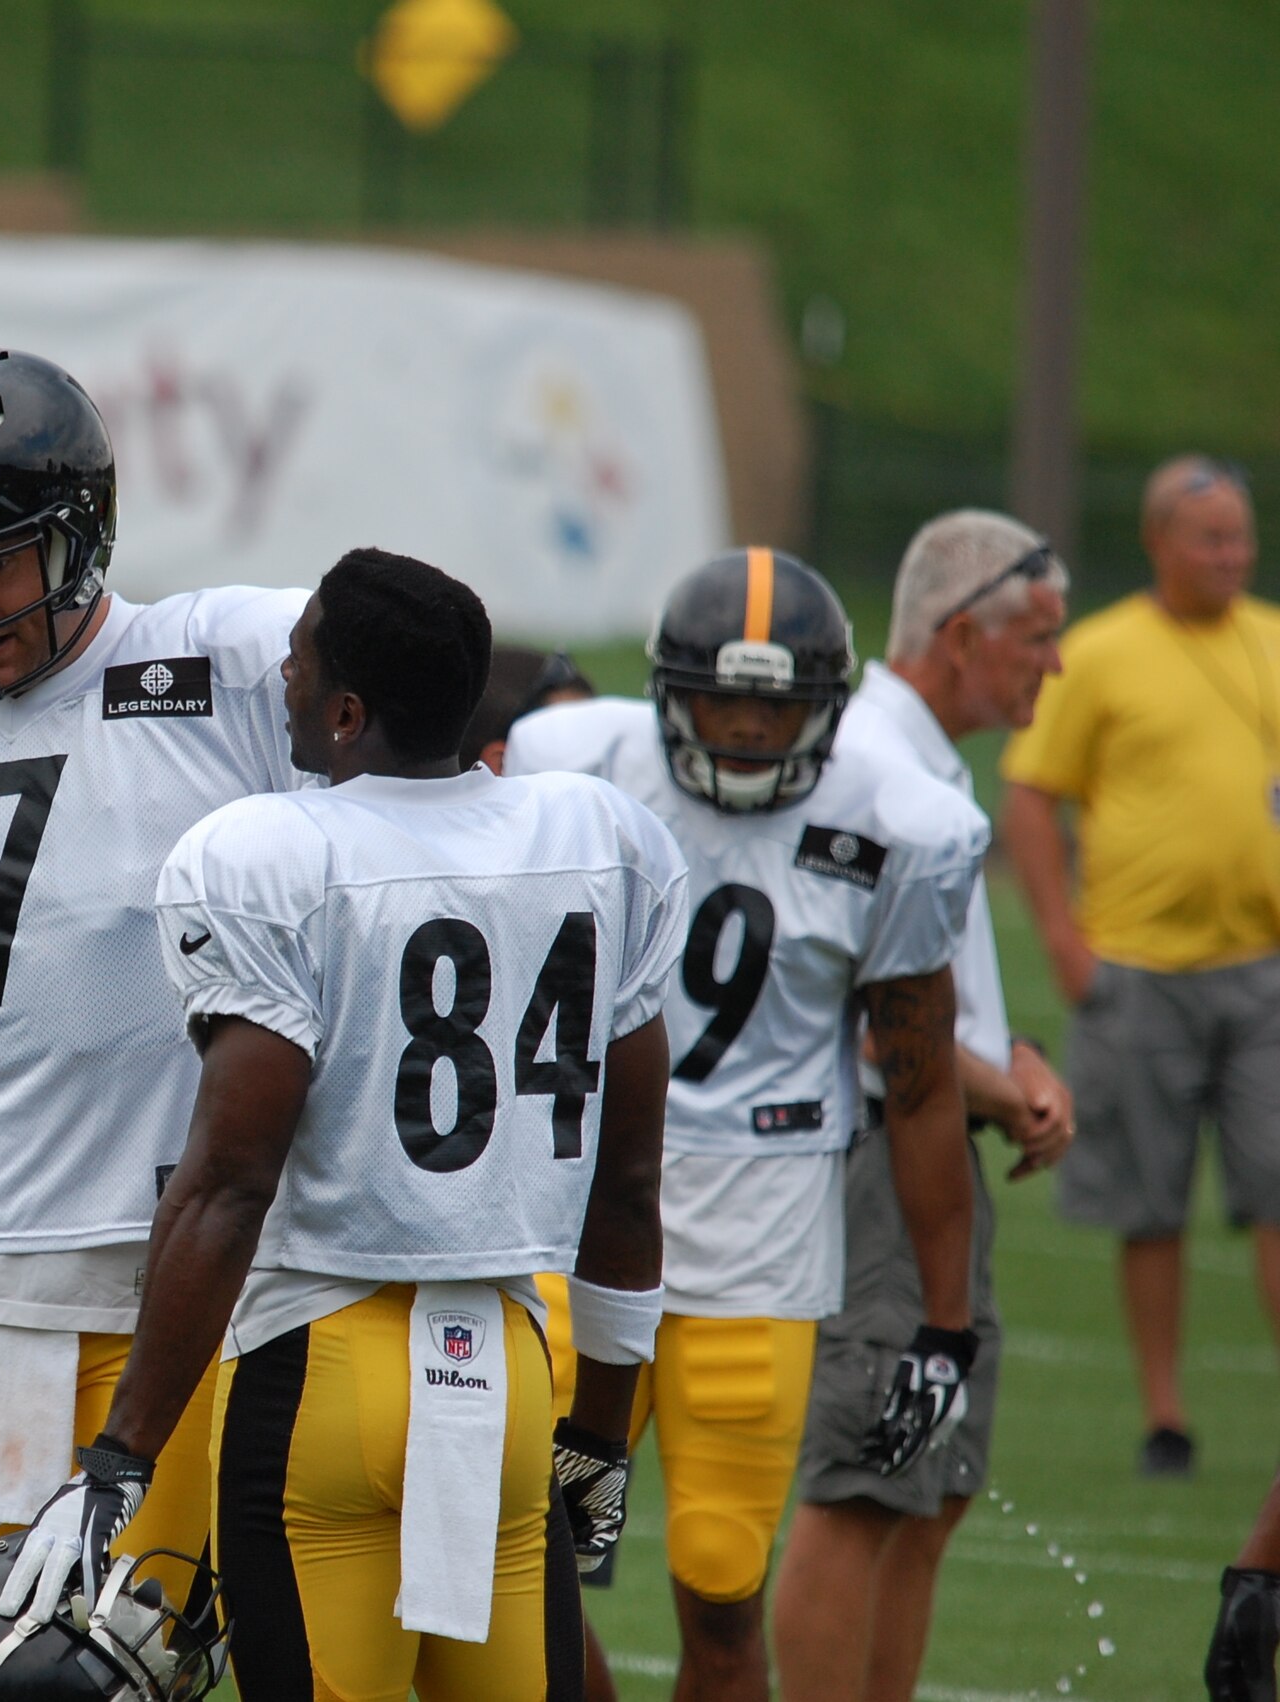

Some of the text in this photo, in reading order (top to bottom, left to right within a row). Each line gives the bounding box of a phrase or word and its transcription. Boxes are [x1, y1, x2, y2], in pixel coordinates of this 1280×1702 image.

[108, 700, 206, 714] LEGENDARY
[394, 912, 600, 1173] 84
[432, 1314, 483, 1328] EQUIPMENT
[447, 1339, 470, 1357] NFL
[425, 1368, 490, 1391] Wilson
